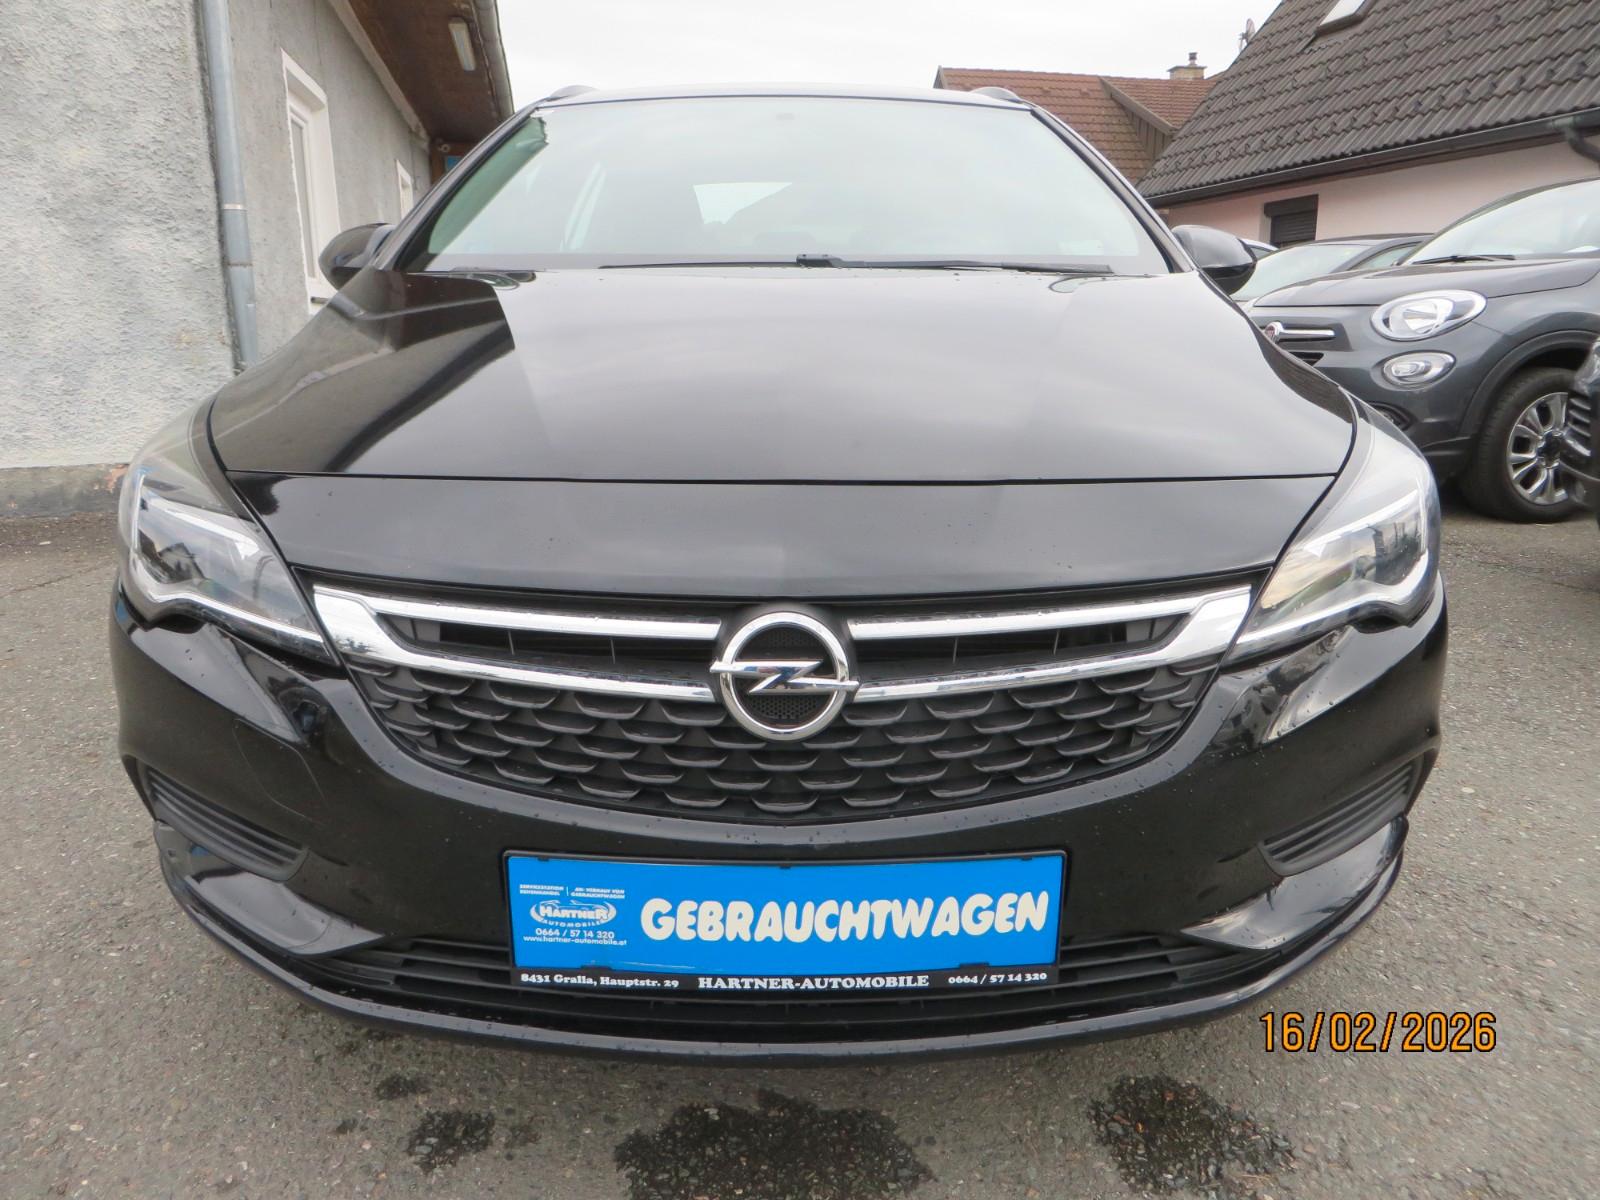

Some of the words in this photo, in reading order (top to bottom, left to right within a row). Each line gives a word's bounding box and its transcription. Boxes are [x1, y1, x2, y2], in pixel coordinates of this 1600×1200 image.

[540, 904, 609, 920] HARTNER
[641, 891, 1049, 943] GEBRAUCHTWAGEN
[523, 935, 627, 946] www.hartner-automobile.at
[535, 927, 560, 937] 0664
[570, 929, 581, 938] 57
[583, 930, 594, 938] 14
[597, 931, 615, 939] 320
[520, 973, 551, 983] 8431
[554, 974, 597, 986] Gralla,
[600, 976, 661, 988] Hauptstr.
[664, 980, 679, 988] 29
[698, 975, 929, 990] HARTNER-AUTOMOBILE
[948, 975, 978, 984] 0664
[990, 974, 1004, 984] 57
[1007, 973, 1023, 983] 14
[1025, 972, 1047, 981] 320
